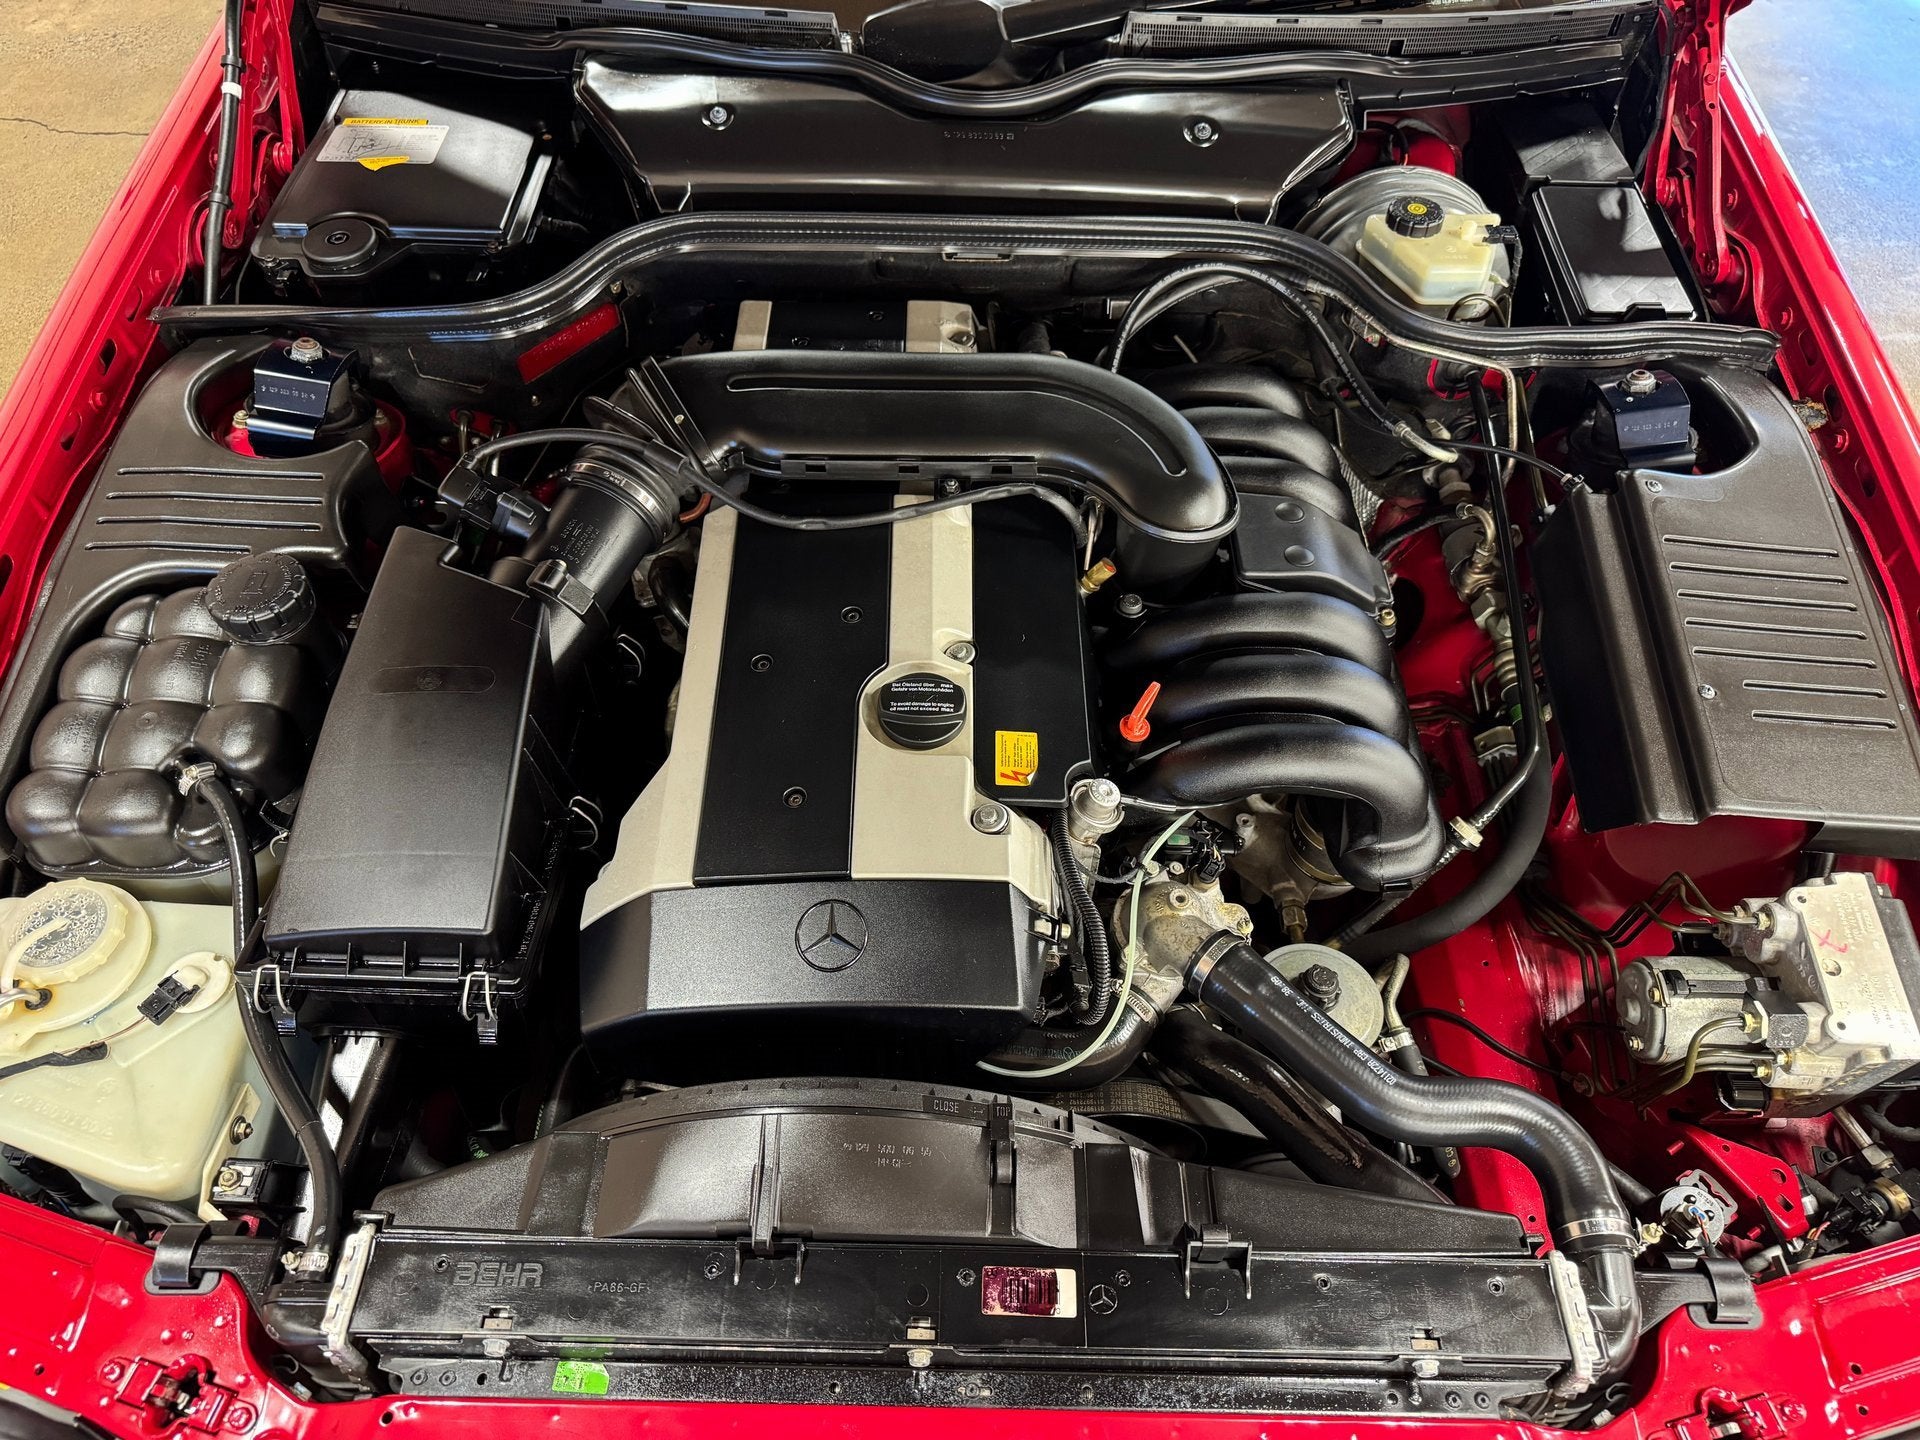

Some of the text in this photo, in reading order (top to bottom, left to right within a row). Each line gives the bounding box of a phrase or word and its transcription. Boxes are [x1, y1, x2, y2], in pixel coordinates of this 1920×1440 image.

[1310, 1012, 1355, 1048] INDUSTRIES
[933, 1099, 1011, 1117] CLOSE TOP
[453, 1261, 544, 1287] BEHR
